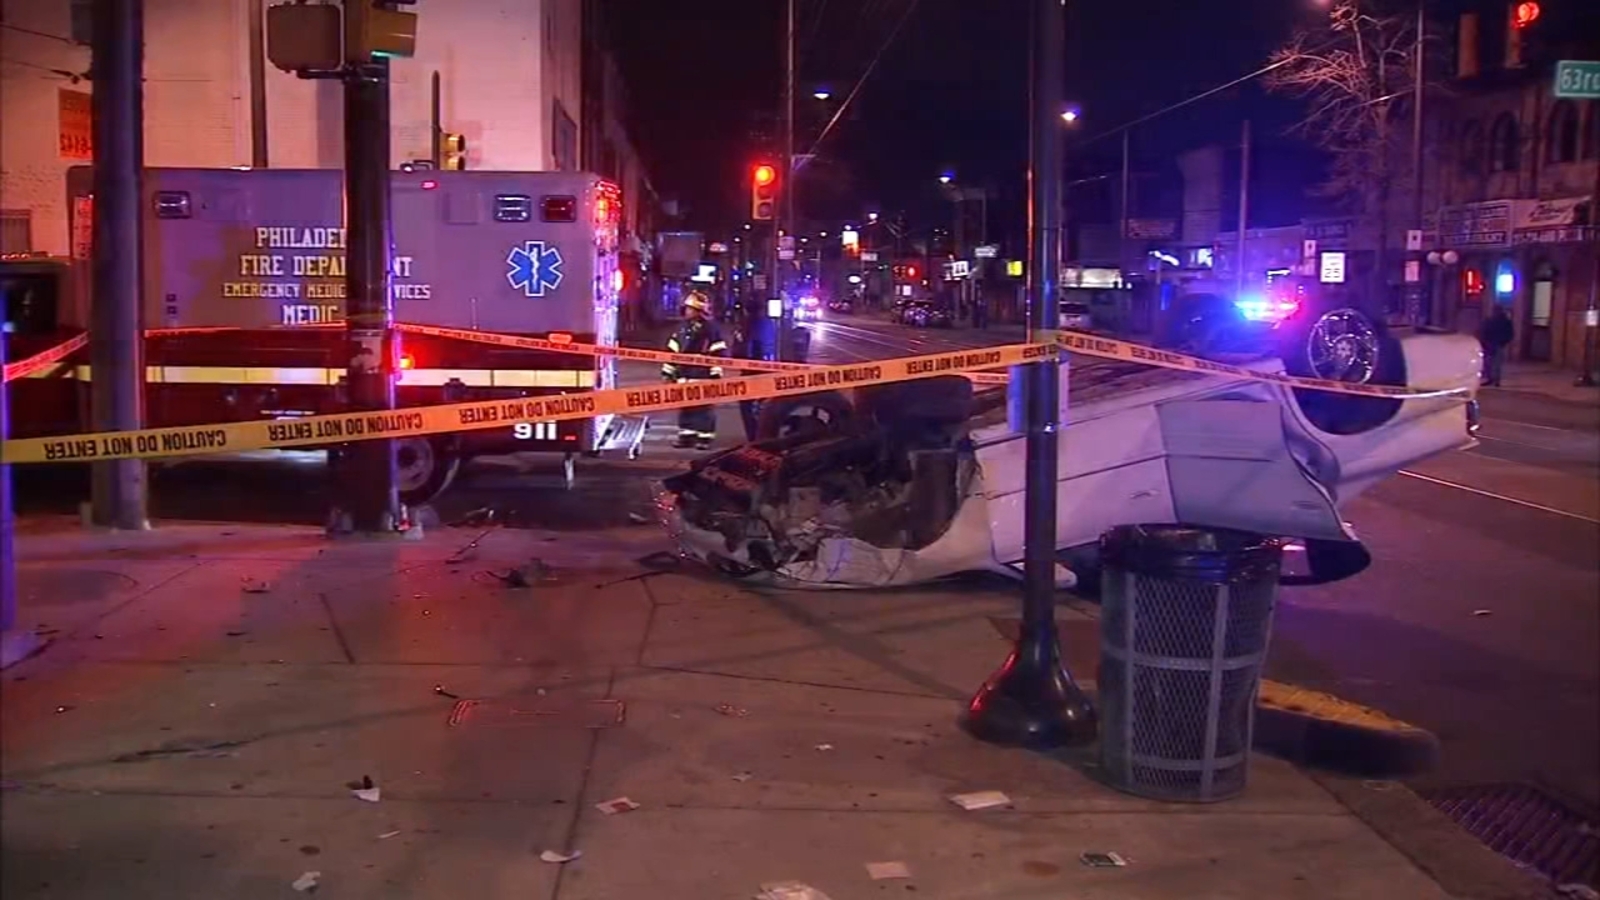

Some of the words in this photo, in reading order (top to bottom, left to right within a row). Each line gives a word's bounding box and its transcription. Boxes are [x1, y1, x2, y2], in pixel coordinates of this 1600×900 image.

[256, 227, 347, 248] PHILADE
[240, 255, 284, 276] FIRE
[293, 255, 412, 277] DEPANT
[223, 282, 300, 298] EMERGENCY
[307, 283, 347, 298] MEDIC
[394, 284, 431, 300] VICES
[282, 305, 338, 325] MEDIC
[906, 359, 933, 375] ENTER
[935, 357, 952, 372] NOT
[953, 355, 965, 368] DO
[965, 351, 1000, 368] CAUTION
[774, 374, 806, 391] ENTER
[807, 371, 826, 387] NOT
[827, 369, 842, 384] DO
[843, 365, 881, 383] CAUTION
[626, 390, 661, 407] ENTER
[664, 386, 685, 404] NOT
[686, 384, 701, 401] DO
[702, 381, 747, 399] CAUTION
[499, 405, 525, 420] NOT
[526, 403, 544, 418] DO
[548, 396, 596, 416] CAUTION
[367, 412, 423, 433] CAUTION
[459, 406, 498, 425] ENTER
[267, 422, 313, 442] ENTER
[315, 419, 343, 438] NOT
[345, 418, 365, 435] DO
[513, 423, 557, 440] 911
[102, 437, 132, 456] NOT
[136, 434, 157, 452] DO
[161, 429, 227, 451] CAUTION
[43, 439, 97, 460] ENTER
